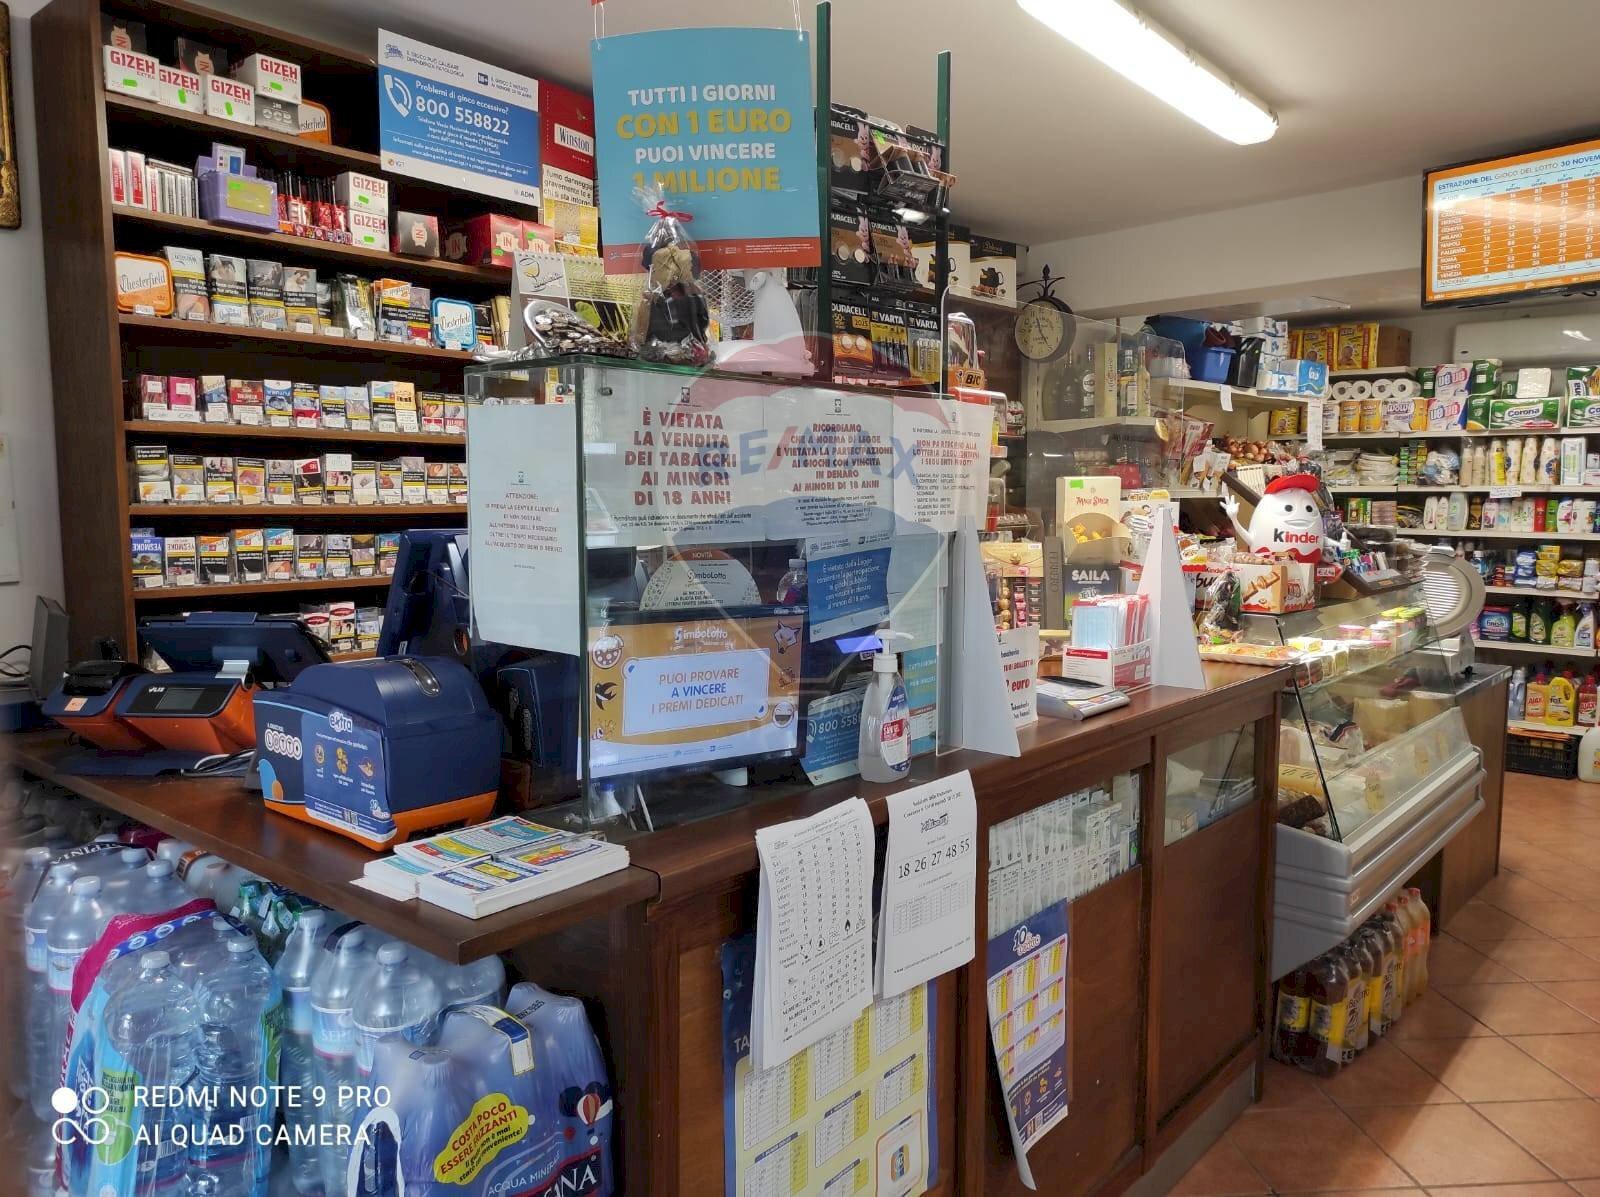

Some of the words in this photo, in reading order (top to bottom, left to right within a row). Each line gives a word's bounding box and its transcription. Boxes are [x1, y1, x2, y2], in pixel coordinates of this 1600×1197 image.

[110, 50, 156, 75] GIZEH
[260, 58, 298, 80] GIZEH
[160, 69, 200, 92] GIZEH
[211, 79, 250, 100] GIZEH
[416, 80, 448, 98] Problemi
[449, 89, 456, 98] di
[458, 95, 475, 108] gioco
[476, 98, 509, 115] eccessivo?
[627, 86, 686, 107] TUTTI
[691, 85, 698, 102] I
[702, 84, 776, 102] GIORNI
[416, 96, 450, 118] 800
[456, 106, 510, 136] 558822
[616, 112, 680, 140] CON
[687, 110, 699, 134] 1
[708, 108, 793, 134] EURO
[559, 126, 590, 153] Winston
[635, 145, 684, 164] PUOI
[688, 142, 776, 162] VINCERE
[632, 171, 646, 190] 1
[654, 166, 782, 194] MILIONE
[1438, 176, 1479, 191] ESTRAZIONE
[1480, 175, 1493, 183] DEL
[1534, 162, 1558, 172] LOTTO
[1561, 160, 1571, 168] 30
[352, 176, 386, 195] GIZEH
[520, 190, 534, 200] ADM
[354, 214, 386, 230] GIZEH
[870, 222, 898, 233] DURACELL
[504, 238, 512, 247] IN
[120, 270, 166, 293] Chesterfield
[832, 303, 867, 316] DURACELL
[879, 312, 904, 326] VARTA
[916, 318, 938, 330] VARTA
[966, 374, 982, 386] BIC
[642, 406, 652, 426] È
[658, 410, 724, 430] VIETATA
[1507, 407, 1540, 418] Corona
[812, 423, 862, 433] RICORDIAMO
[634, 430, 654, 447] LA
[662, 431, 730, 449] VENDITA
[790, 435, 806, 444] CHE
[816, 434, 845, 444] NORMA
[858, 434, 881, 443] LEGGE
[624, 450, 654, 467] DEI
[659, 451, 737, 468] TABACCHI
[784, 446, 818, 457] VIETATA
[819, 446, 830, 456] LA
[832, 446, 894, 456] PARTECIPAZIONE
[792, 459, 802, 468] AI
[803, 458, 831, 468] GIOCHI
[832, 458, 850, 467] CON
[852, 457, 881, 467] VINCITA
[640, 470, 659, 486] AI
[666, 471, 730, 486] MINORI
[816, 470, 824, 480] IN
[793, 483, 802, 492] AI
[803, 482, 834, 492] MINORI
[835, 482, 847, 490] DI
[861, 480, 880, 490] ANNI
[634, 490, 654, 506] DI
[662, 490, 683, 506] 18
[132, 542, 162, 552] YESMOKE
[1071, 570, 1110, 582] SAILA
[659, 672, 687, 686] PUOI
[690, 668, 740, 684] PROVARE
[1011, 678, 1030, 692] euro
[671, 686, 680, 698] A
[682, 682, 727, 697] VINCERE
[651, 703, 655, 715] I
[658, 700, 692, 714] PREMI
[695, 695, 744, 712] DEDICATI
[818, 719, 838, 733] 800
[264, 729, 302, 760] LOTTO
[898, 862, 910, 880] 18
[914, 856, 927, 874] 26
[931, 850, 942, 867] 27
[946, 844, 957, 859] 48
[960, 838, 970, 854] 55
[452, 1122, 478, 1152] COSTA
[477, 1102, 507, 1126] POCO
[496, 1125, 511, 1138] mai
[440, 1144, 474, 1175] ESSERE
[474, 1110, 518, 1148] FRIZZANTI
[488, 1178, 527, 1196] ACQUA
